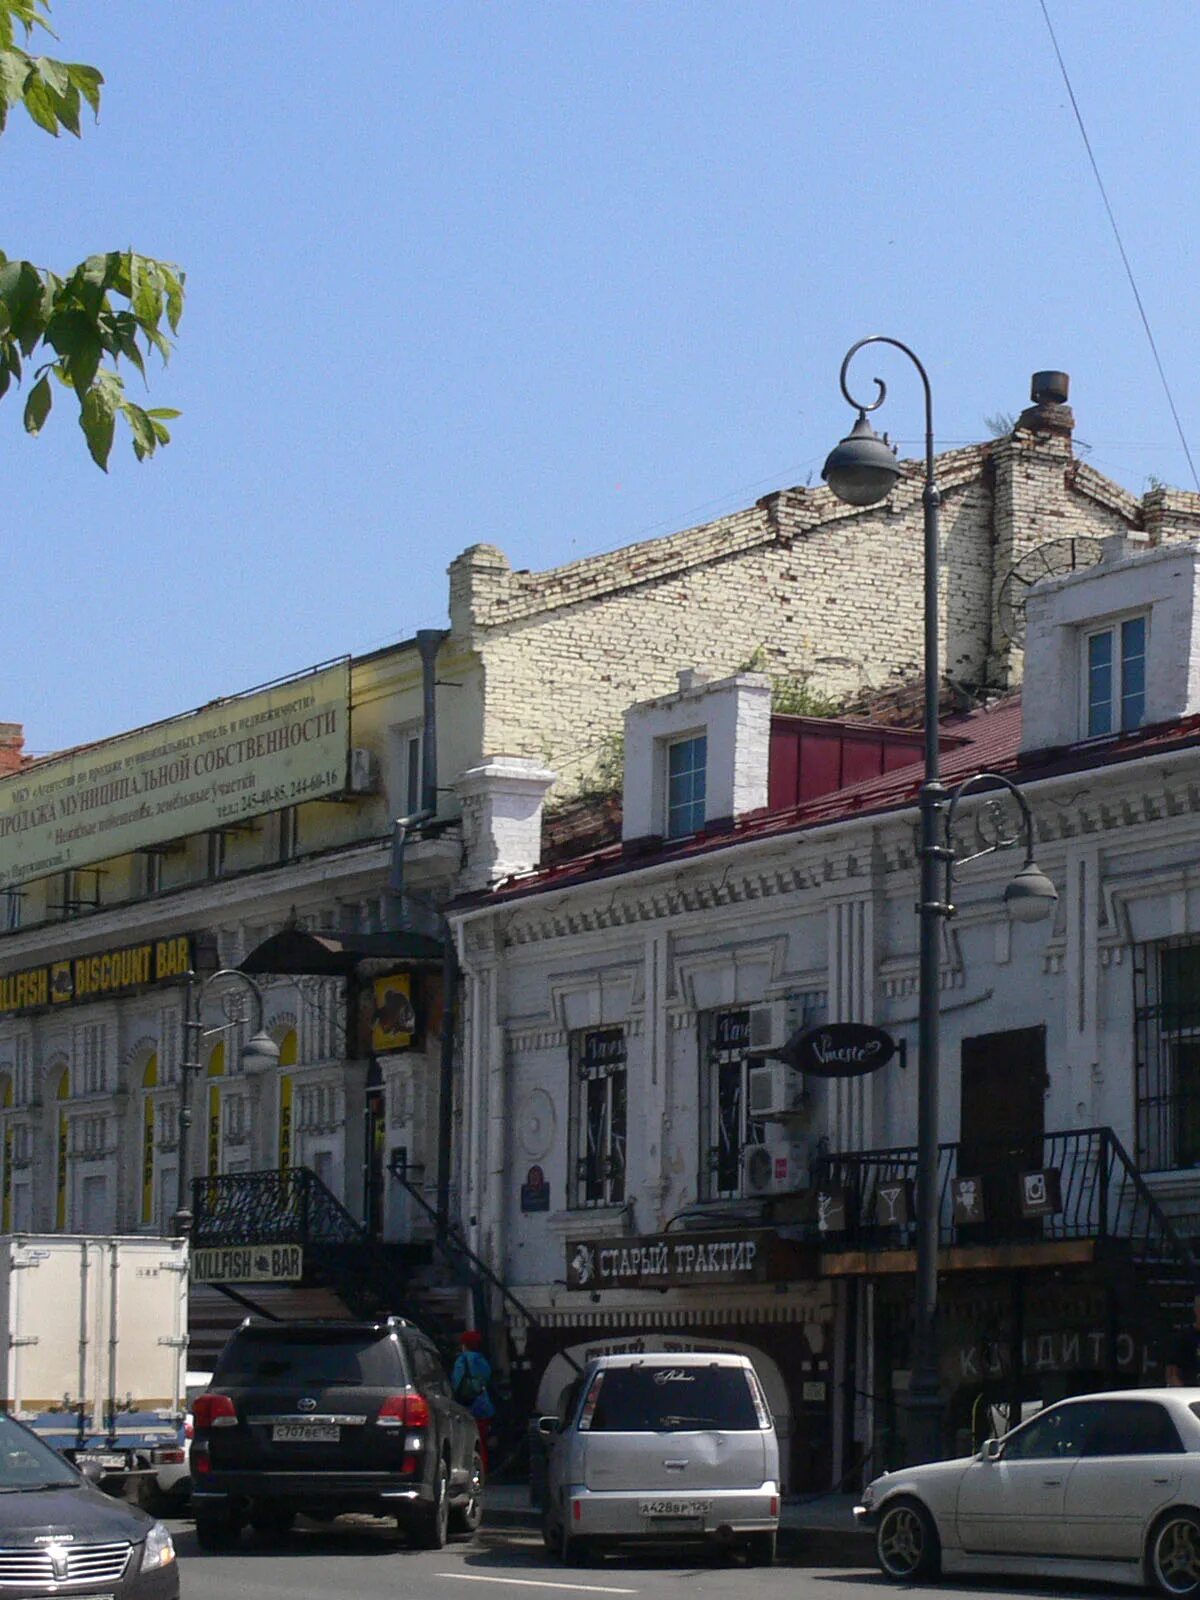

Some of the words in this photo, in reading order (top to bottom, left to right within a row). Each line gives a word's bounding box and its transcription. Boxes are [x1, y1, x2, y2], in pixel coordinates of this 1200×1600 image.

[60, 753, 190, 817] МУНИЦИПАЛЬНОЙ
[194, 709, 337, 777] СОБСТВЕННОСТИ
[74, 946, 153, 999] DISCOUNT
[156, 936, 190, 979] BAR
[194, 1250, 252, 1280] KILLFISH
[271, 1247, 300, 1276] BAR
[600, 1241, 669, 1277] СТАРЫЙ
[674, 1240, 757, 1274] ТРАКТИР
